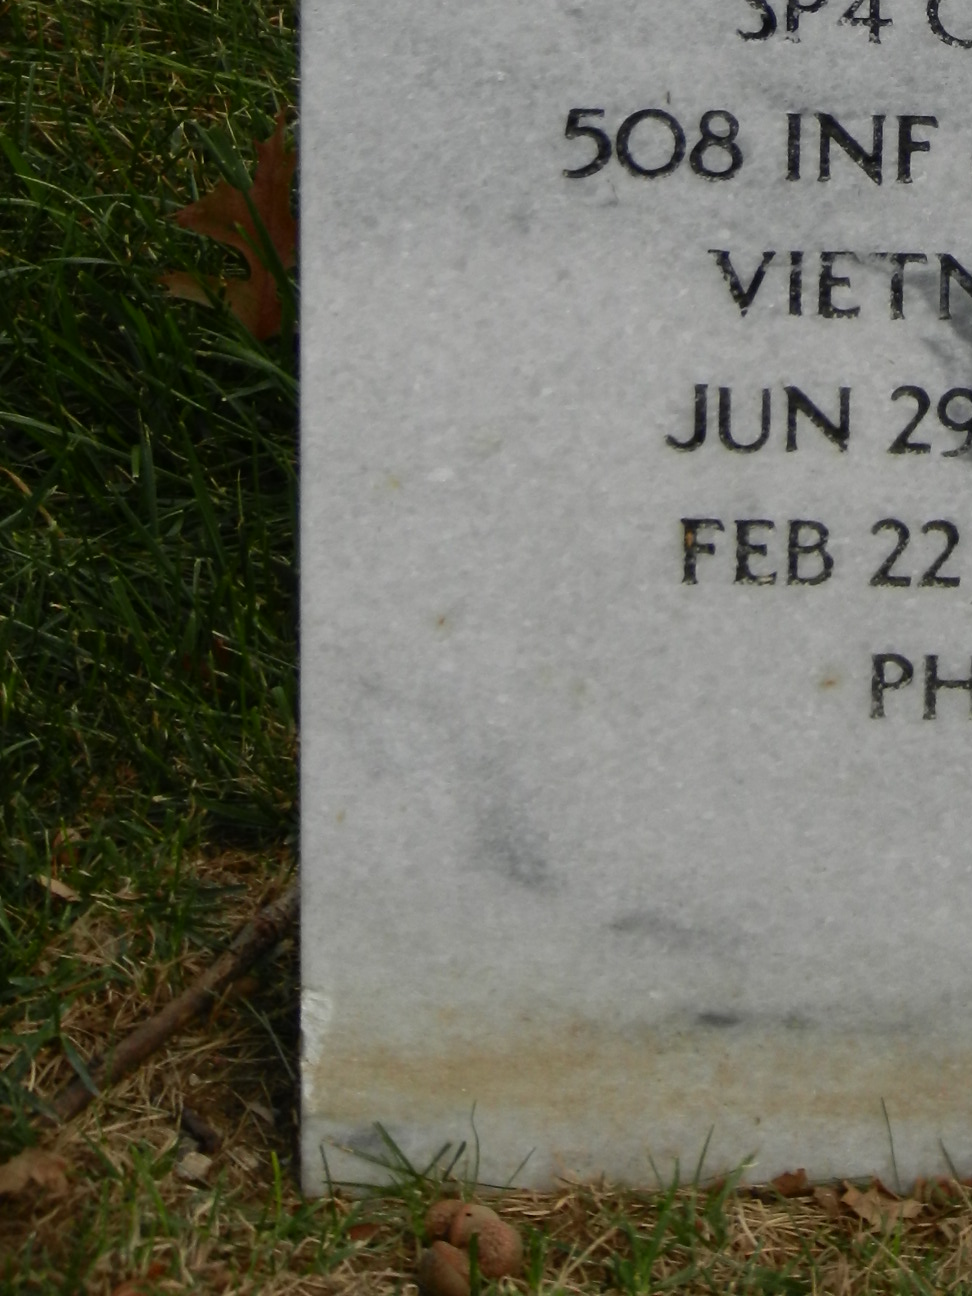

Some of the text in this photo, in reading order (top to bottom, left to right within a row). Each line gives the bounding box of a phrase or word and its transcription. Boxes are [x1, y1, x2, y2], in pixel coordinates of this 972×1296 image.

[562, 107, 744, 184] 508
[784, 108, 939, 187] INF
[664, 383, 852, 454] JUN
[679, 517, 835, 588] FEB
[869, 517, 961, 589] 22
